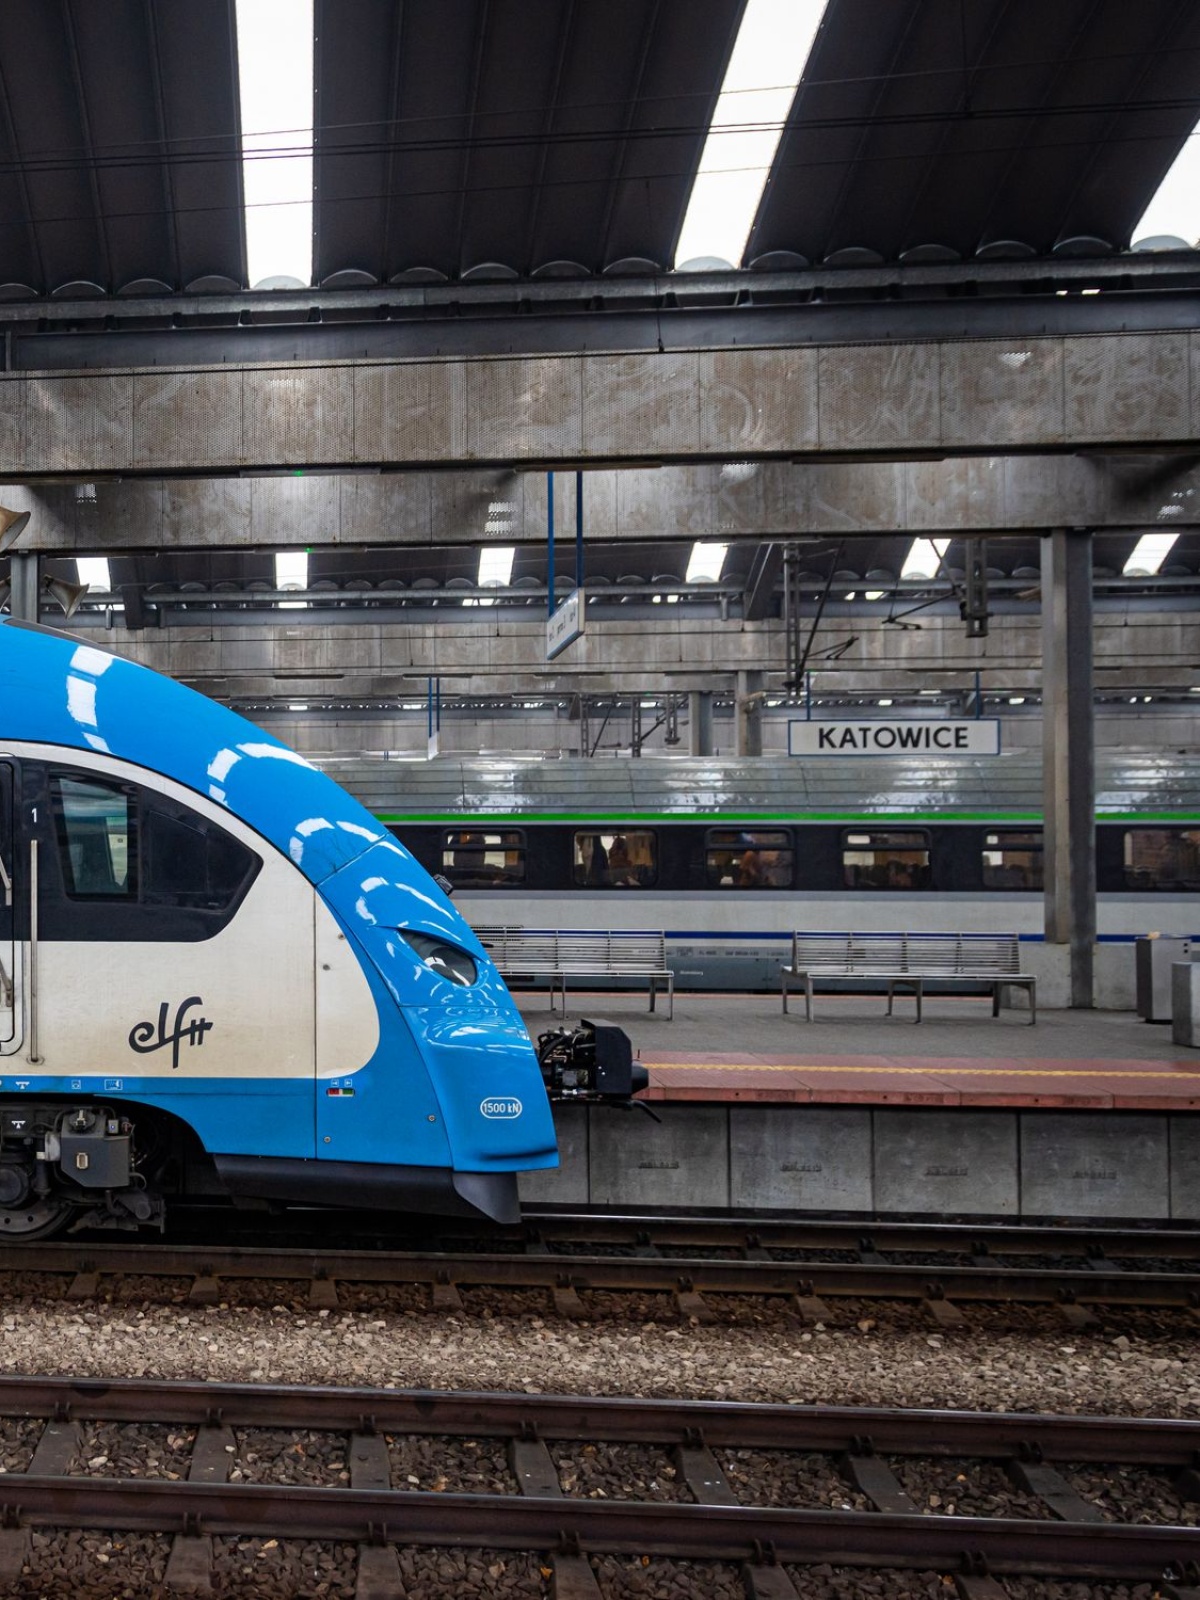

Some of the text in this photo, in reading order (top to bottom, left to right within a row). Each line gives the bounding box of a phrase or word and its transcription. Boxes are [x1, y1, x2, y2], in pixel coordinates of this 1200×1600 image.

[818, 726, 969, 748] KATOWICE
[31, 808, 38, 823] 1
[483, 1102, 519, 1114] 1500 kN
